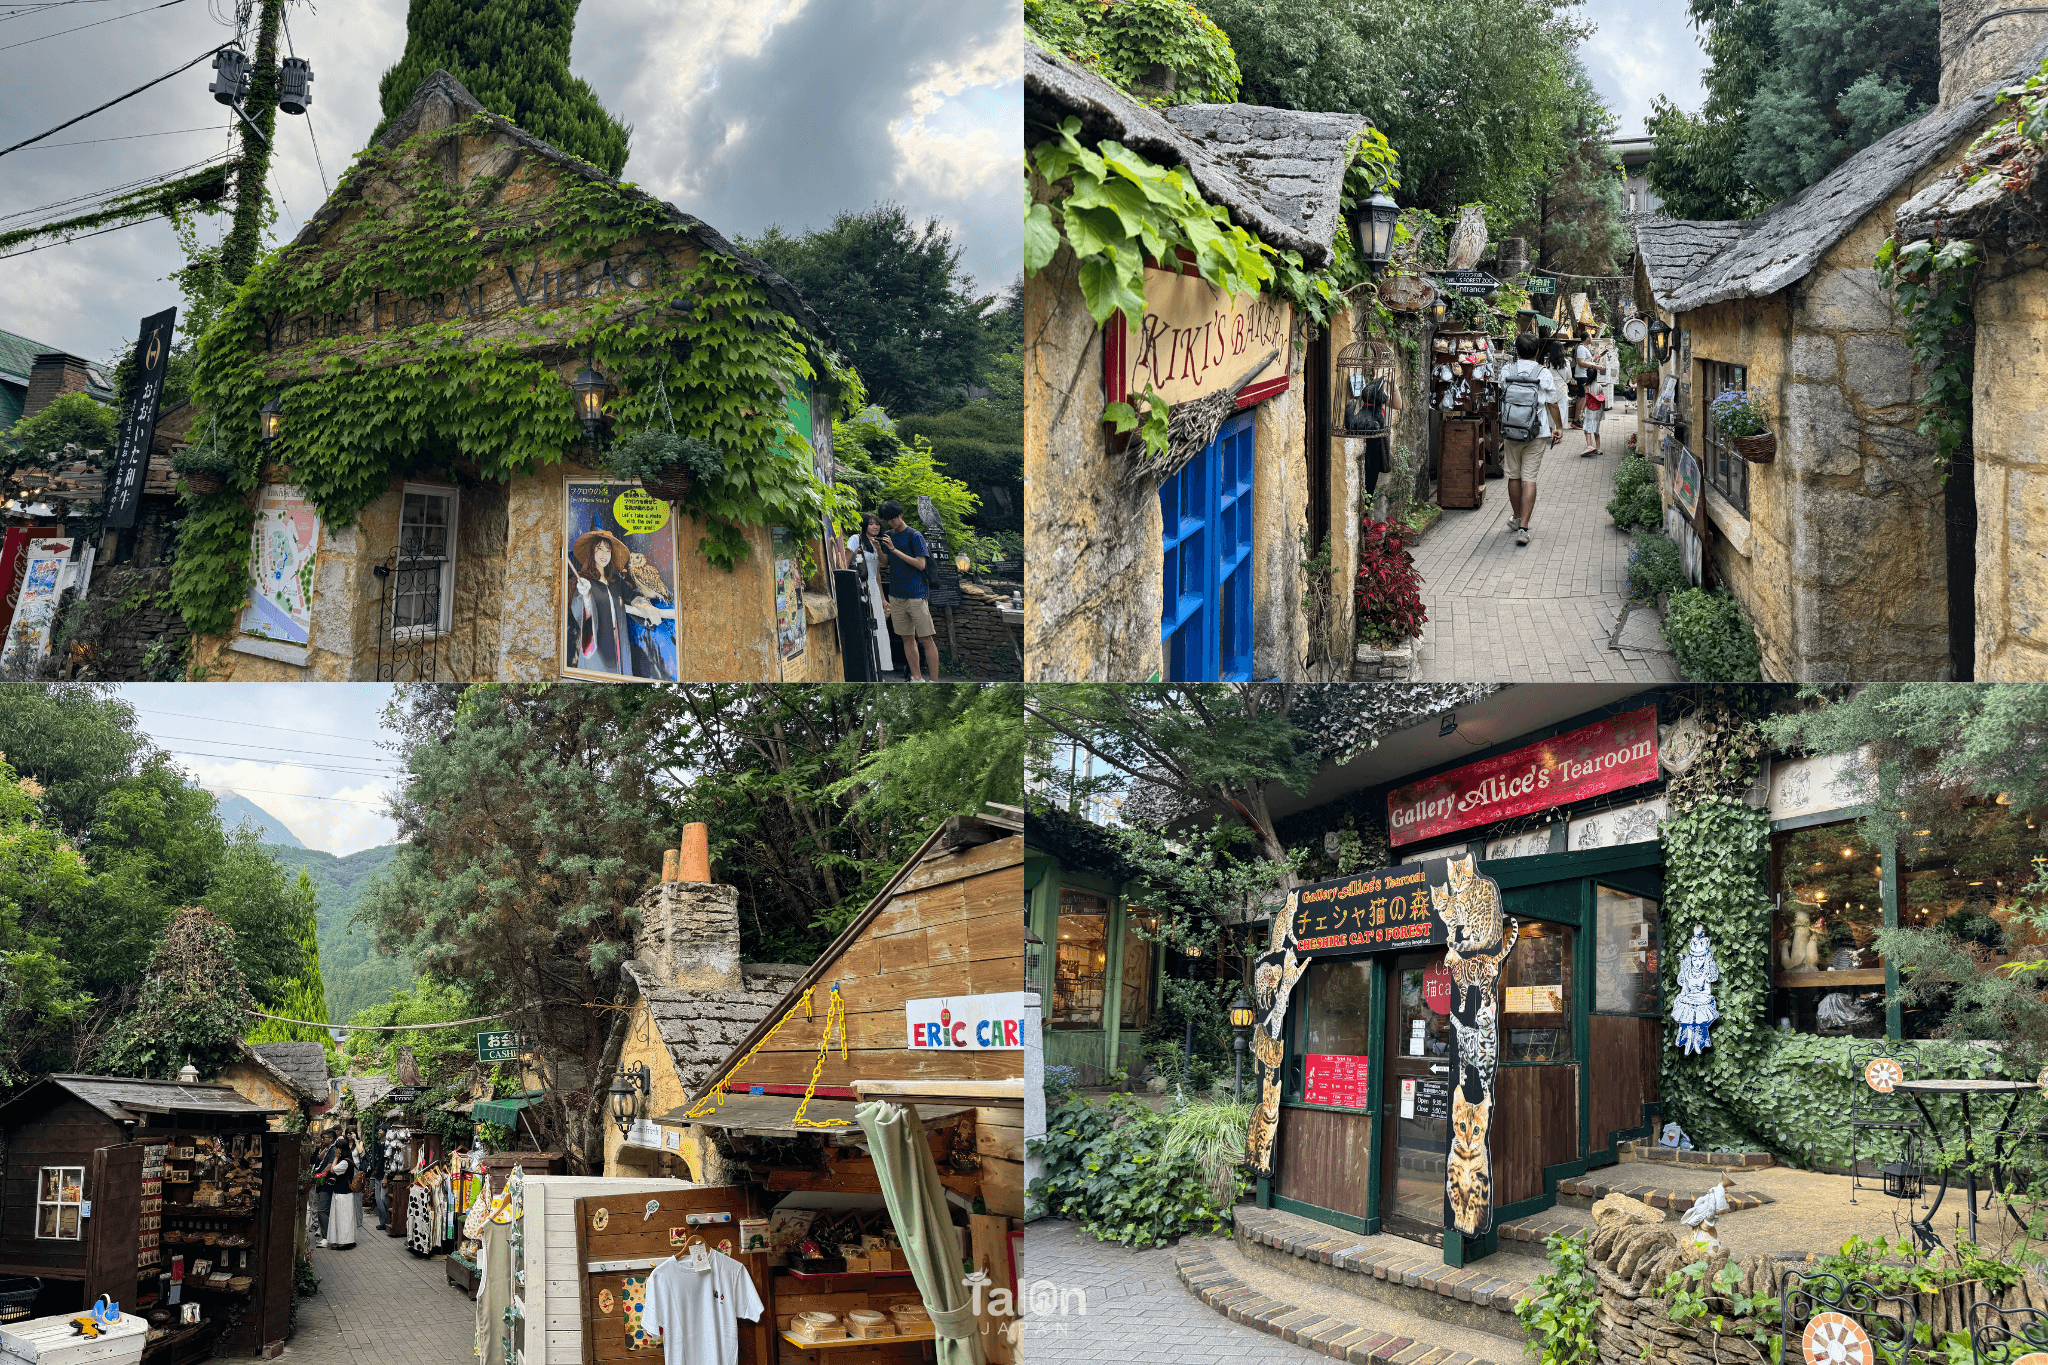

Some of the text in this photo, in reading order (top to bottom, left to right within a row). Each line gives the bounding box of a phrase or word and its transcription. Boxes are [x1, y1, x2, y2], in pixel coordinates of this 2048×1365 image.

[372, 284, 493, 333] FLORAL
[504, 251, 680, 308] VILLAGE
[1456, 285, 1486, 293] Entrance
[1529, 278, 1550, 287] お会計
[1138, 301, 1287, 389] KIKI'S BAKERY
[119, 382, 153, 509] おおいた和牛
[1391, 740, 1653, 828] Gallery Alice's Tearoom
[1302, 872, 1426, 903] Gallery Alice's Tearoom
[1297, 888, 1431, 935] チェシャ猫の森
[1297, 922, 1432, 951] CHESHIRE CAT'S FOREST
[1435, 961, 1450, 976] Ca
[913, 1011, 968, 1047] ERIC
[489, 1050, 518, 1058] CASHI
[1416, 1105, 1429, 1113] Close
[1417, 1096, 1430, 1105] Open
